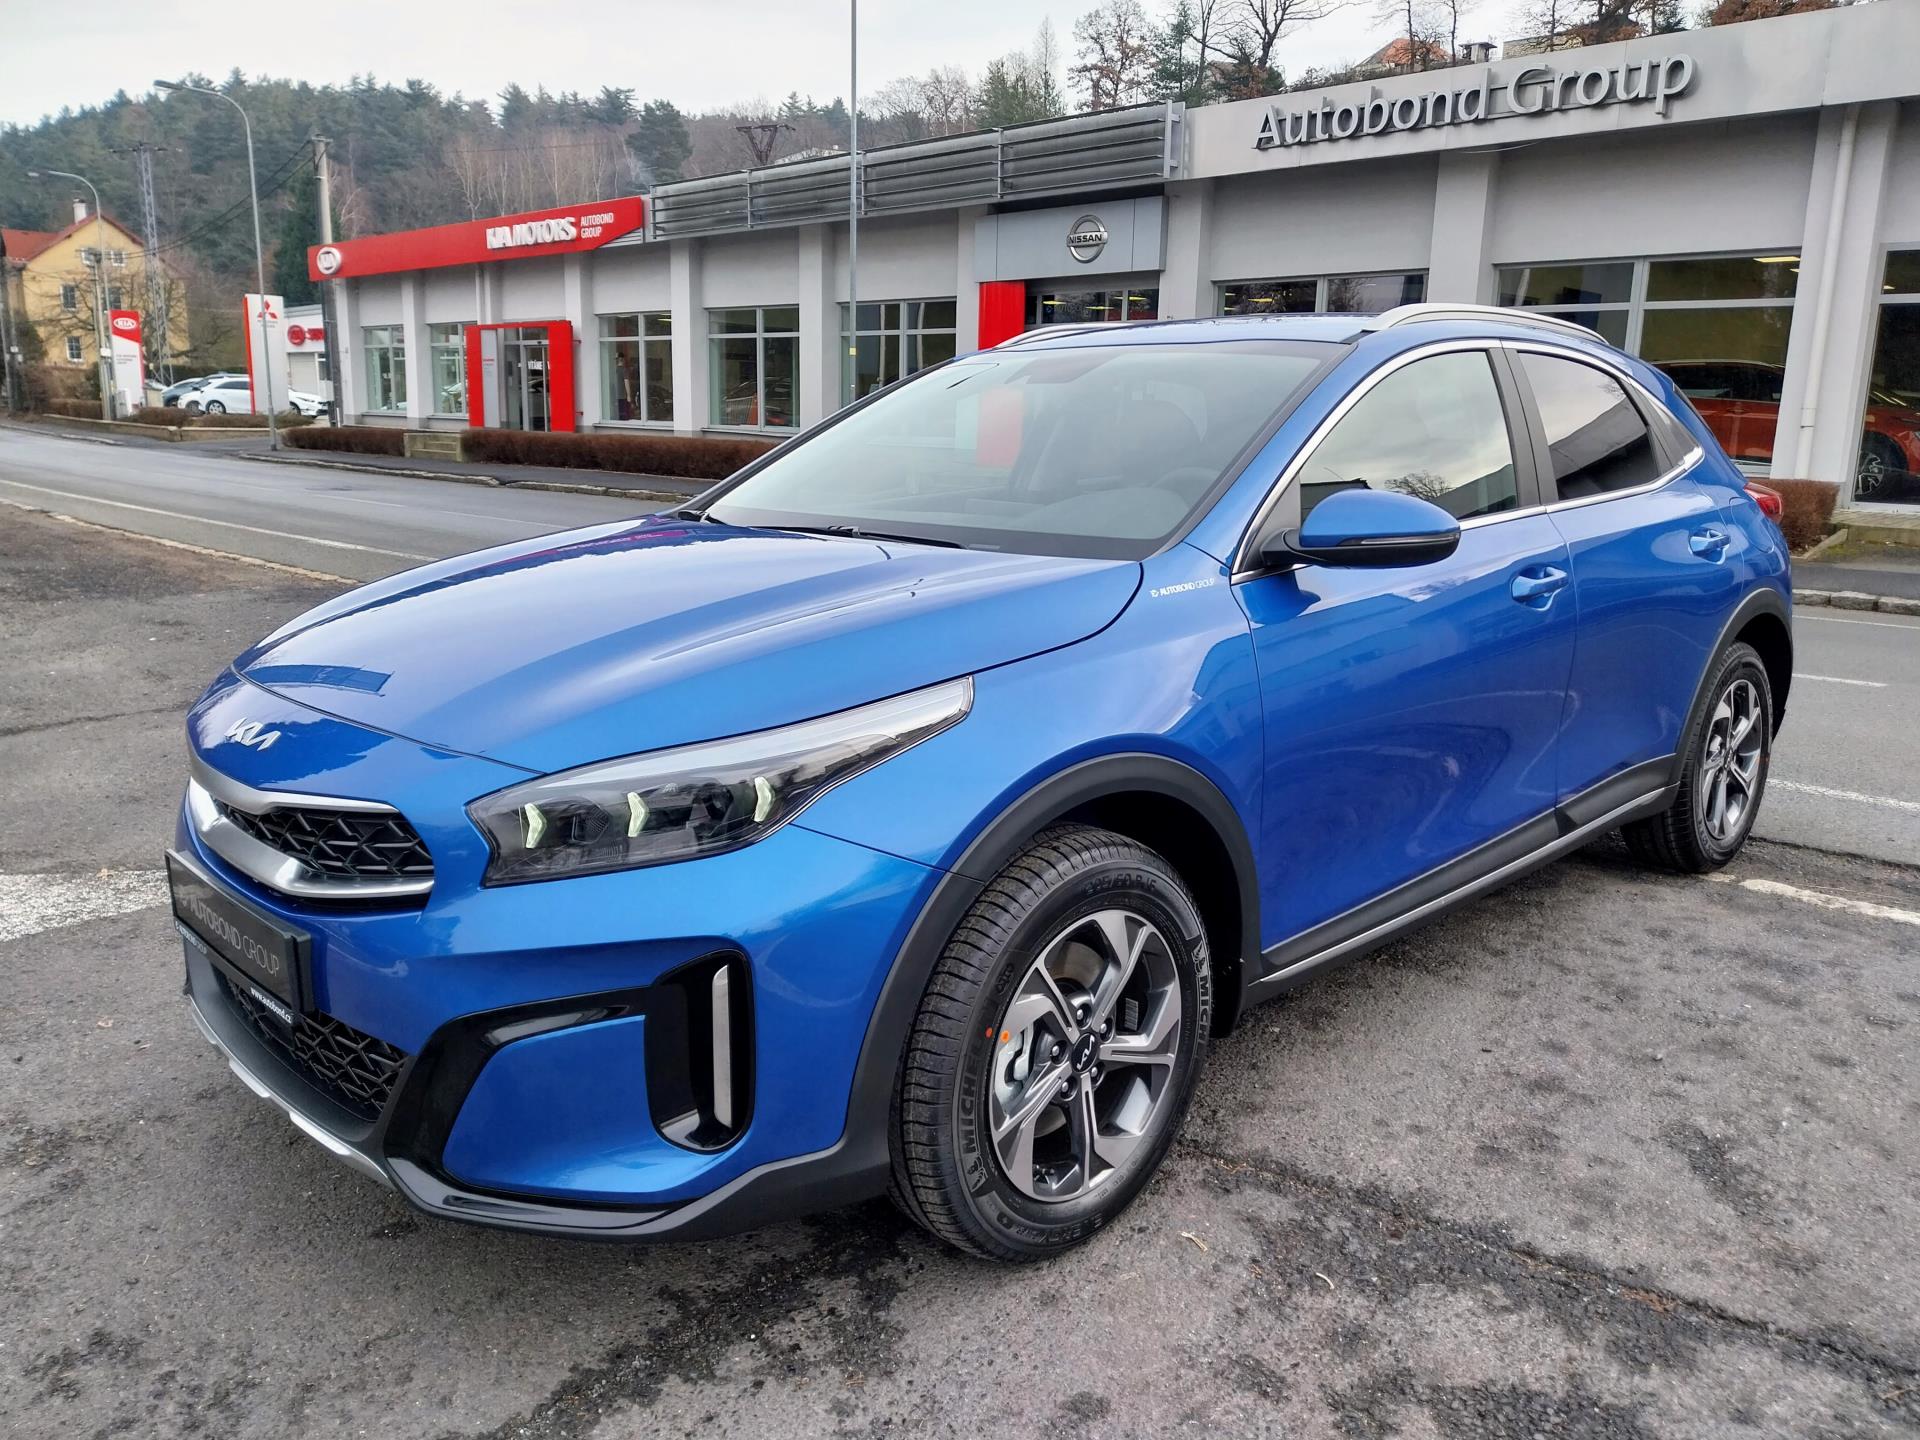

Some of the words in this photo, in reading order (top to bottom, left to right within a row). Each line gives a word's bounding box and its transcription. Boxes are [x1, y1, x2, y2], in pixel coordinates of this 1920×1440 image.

[1252, 67, 1493, 150] Autobond
[1506, 53, 1697, 117] Group
[580, 213, 614, 227] AUTOBOND
[512, 217, 577, 246] MOTORS
[580, 227, 603, 239] GROUP
[1069, 233, 1103, 244] NISSAN
[1160, 582, 1196, 597] AUTOBOND
[189, 897, 242, 950] AUTOBOND
[242, 935, 280, 977] GROUP
